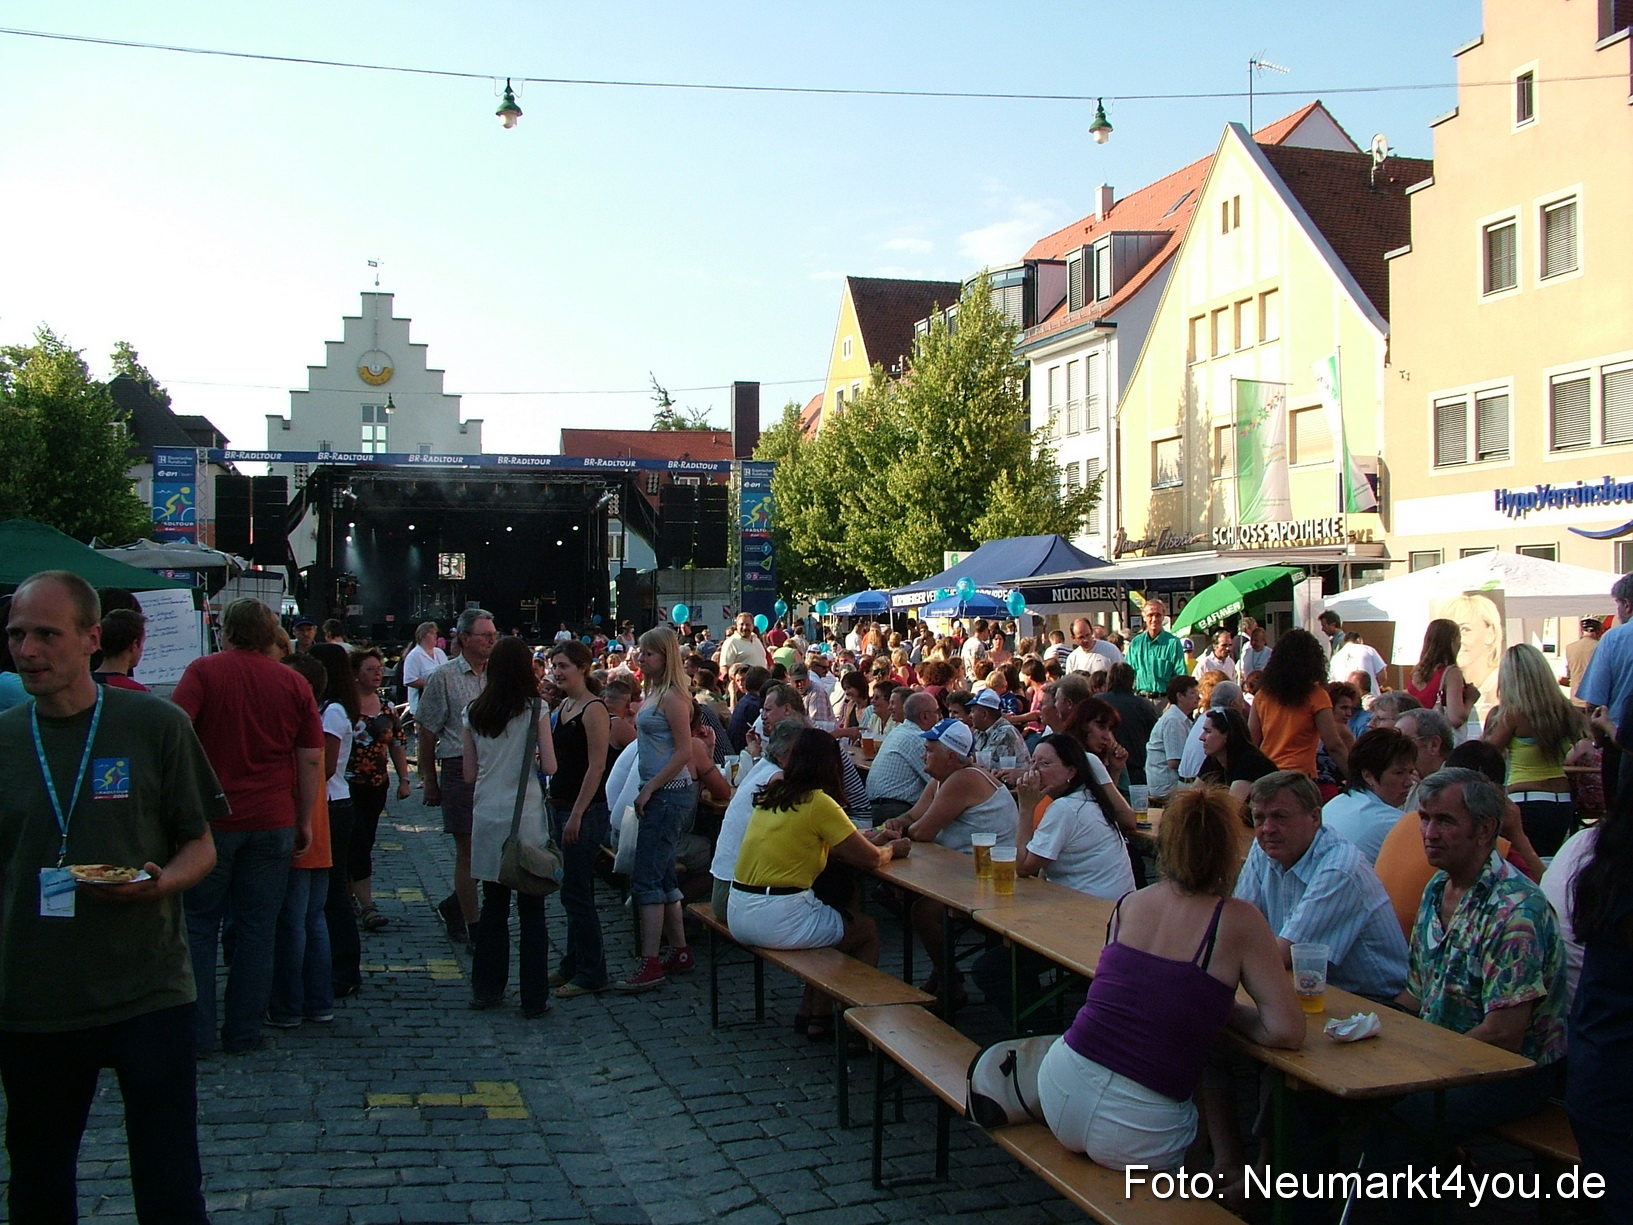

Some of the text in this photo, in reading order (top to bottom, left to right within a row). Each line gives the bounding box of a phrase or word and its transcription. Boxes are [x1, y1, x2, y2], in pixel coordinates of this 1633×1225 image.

[224, 450, 282, 460] BR-RADLTOUR
[317, 451, 374, 462] BR-RADLTOUR
[408, 453, 464, 463] BR-RADLTOUR
[497, 456, 551, 466] BR-RADLTOUR
[584, 458, 636, 468] BR-RADLTOUR
[667, 460, 718, 471] BR-RADLTOUR
